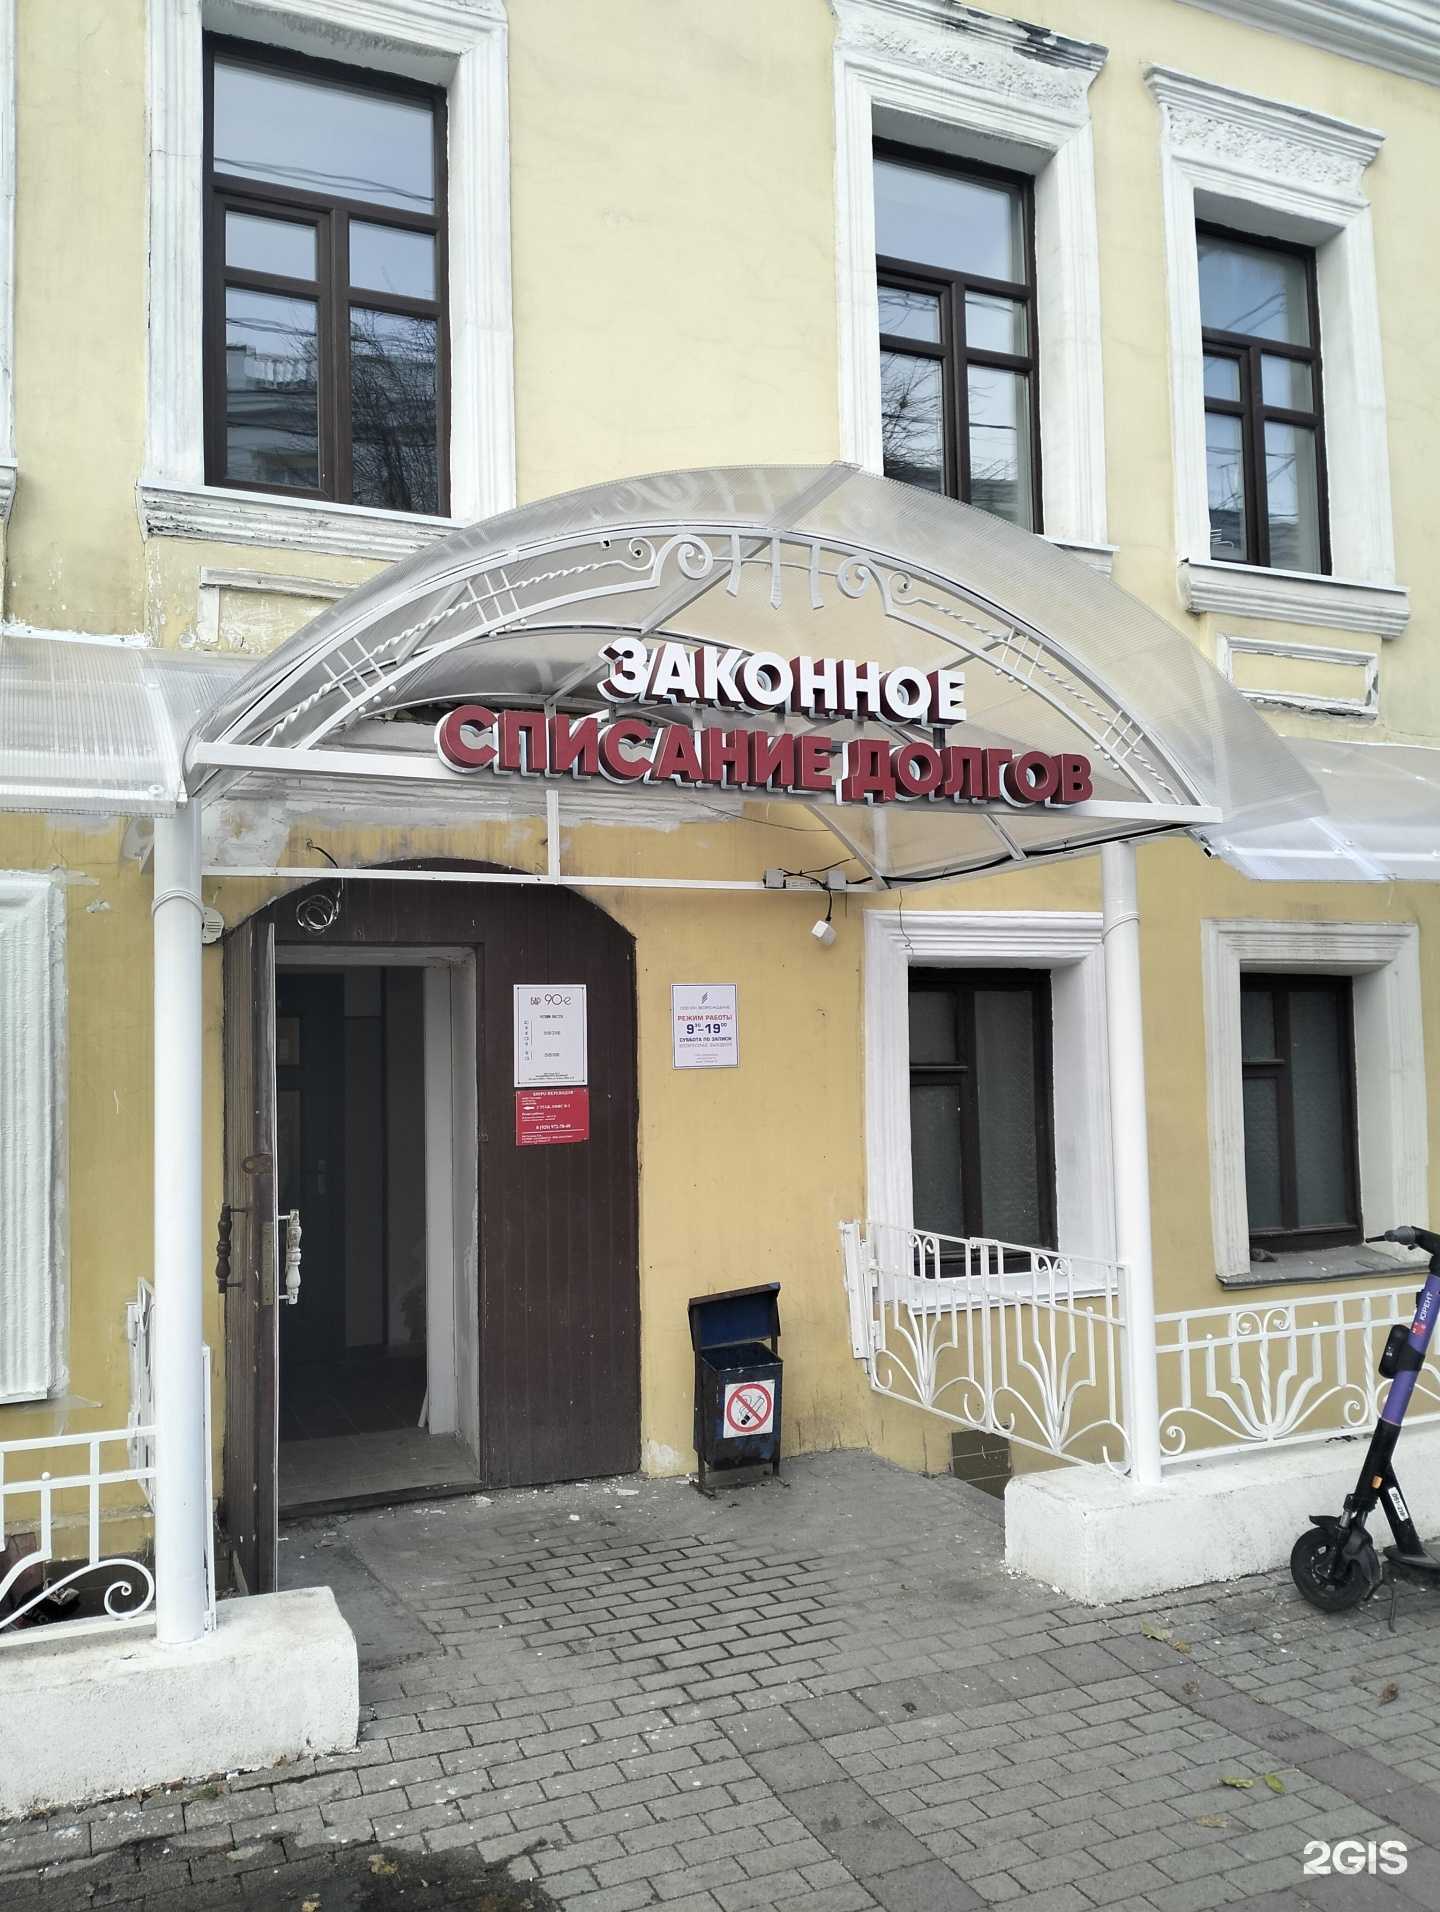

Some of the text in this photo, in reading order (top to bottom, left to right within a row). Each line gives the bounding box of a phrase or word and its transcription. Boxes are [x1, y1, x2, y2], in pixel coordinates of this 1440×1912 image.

[603, 637, 967, 723] ЗАКОННОЕ
[436, 703, 1093, 806] СПИСАНИЕ ДОЛГОВ
[1419, 1291, 1433, 1321] ЮРЕНТ
